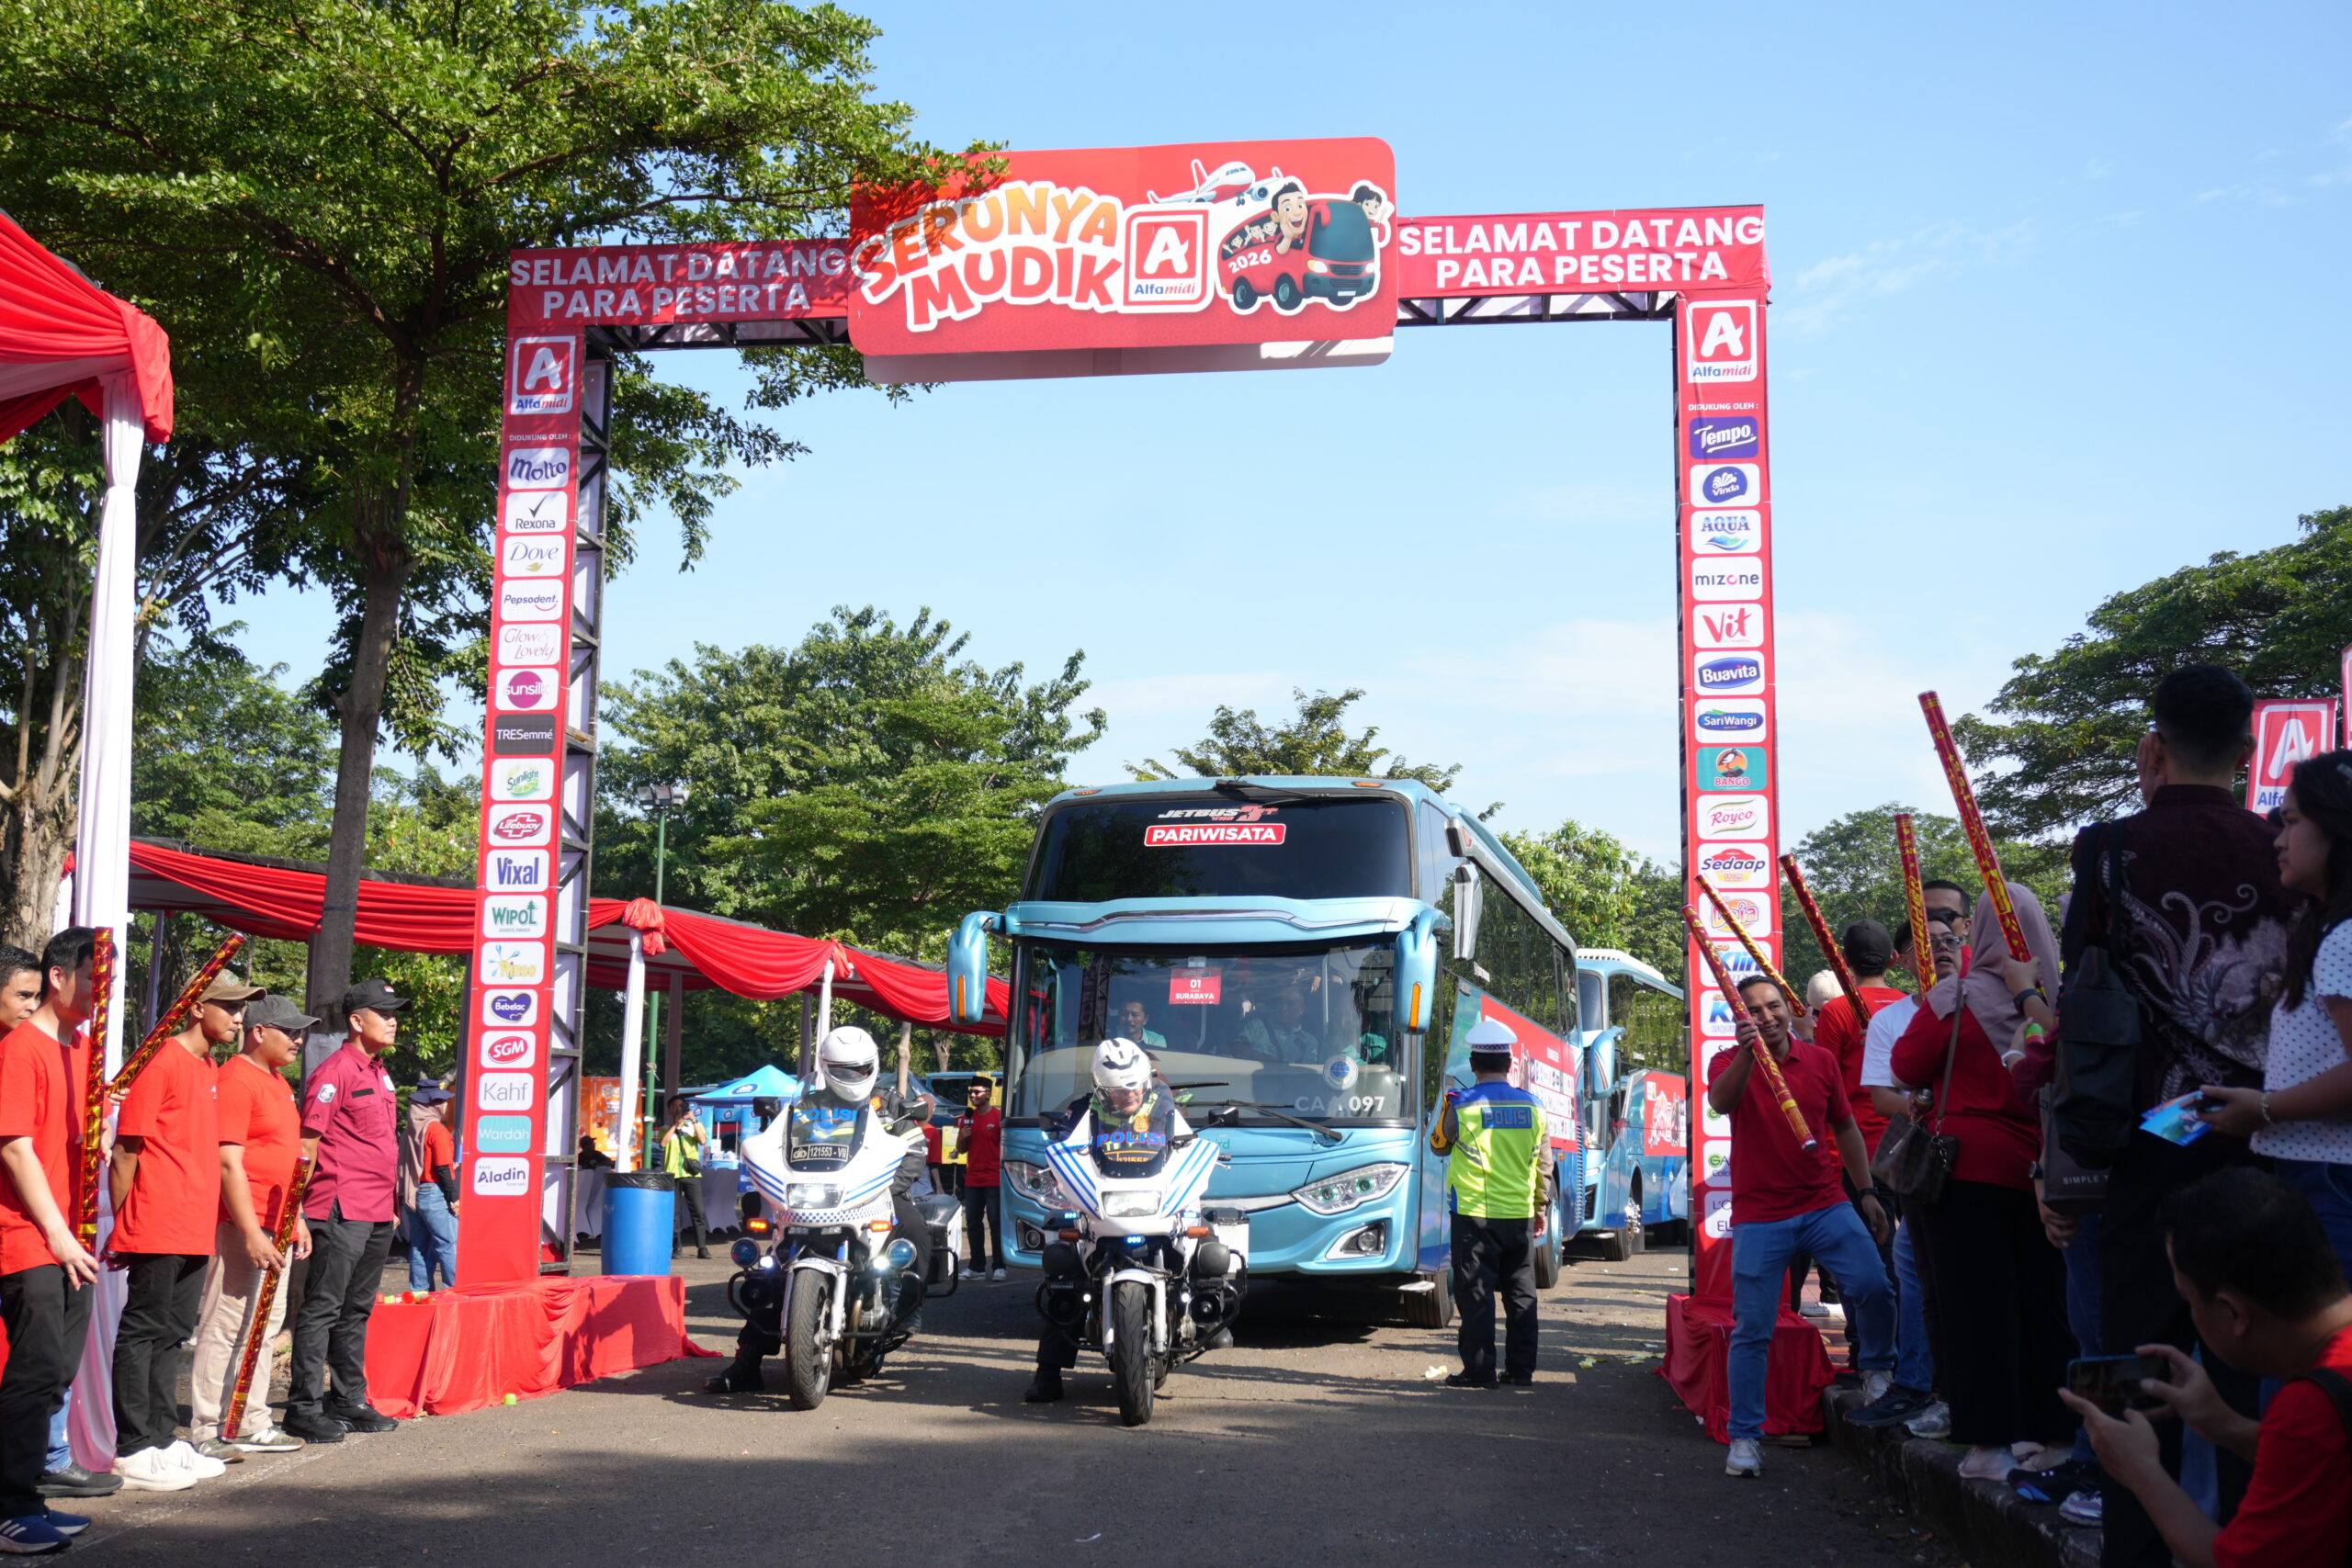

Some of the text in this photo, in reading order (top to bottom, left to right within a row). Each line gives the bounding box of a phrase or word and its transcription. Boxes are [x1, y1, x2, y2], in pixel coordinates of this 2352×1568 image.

[861, 186, 1118, 299] SERUNYA
[1398, 216, 1764, 255] SELAMAT DATANG
[510, 247, 846, 288] SELAMAT DATANG
[1228, 249, 1272, 274] 2026
[1437, 252, 1728, 289] PARA PESERTA
[912, 245, 1123, 325] MUDIK
[1135, 282, 1196, 296] Alfamidi
[543, 283, 810, 319] PARA PESERTA
[1692, 365, 1752, 378] Alfamidi
[515, 398, 569, 410] Alfamidi
[1689, 402, 1731, 412] DIDUKUNG
[1694, 424, 1754, 450] Tempo
[510, 457, 567, 480] Molto
[1713, 484, 1740, 496] Vinda
[515, 518, 556, 529] Rexona
[1701, 516, 1750, 535] AQUA
[510, 542, 559, 561] Dove
[1695, 574, 1759, 585] mizone
[503, 594, 557, 605] Pepsodent
[1702, 607, 1753, 643] Vit
[503, 628, 540, 643] Glow
[514, 645, 555, 660] Lovely
[1702, 664, 1758, 683] Buavita
[1704, 716, 1757, 727] SariWangi
[496, 728, 553, 740] TRESemmé
[507, 769, 539, 791] Sunlight
[1714, 777, 1750, 786] BANGO
[498, 819, 541, 831] Lifebuoy
[1710, 811, 1753, 827] Royco
[1152, 828, 1276, 842] PARIWISATA
[497, 857, 539, 885] Vixal
[1701, 857, 1766, 873] Sedaap
[501, 960, 537, 977] Rinso
[1190, 979, 1202, 988] 01
[494, 1001, 526, 1010] Bebelac
[492, 1040, 526, 1058] SGM
[483, 1082, 528, 1101] Kahf
[1349, 1096, 1385, 1111] 097
[793, 1108, 859, 1123] POLISI
[1484, 1110, 1532, 1125] POLISI
[479, 1128, 529, 1140] Wardah
[1096, 1131, 1167, 1147] POLISI
[810, 1146, 832, 1157] 121553
[478, 1168, 526, 1183] Aladin
